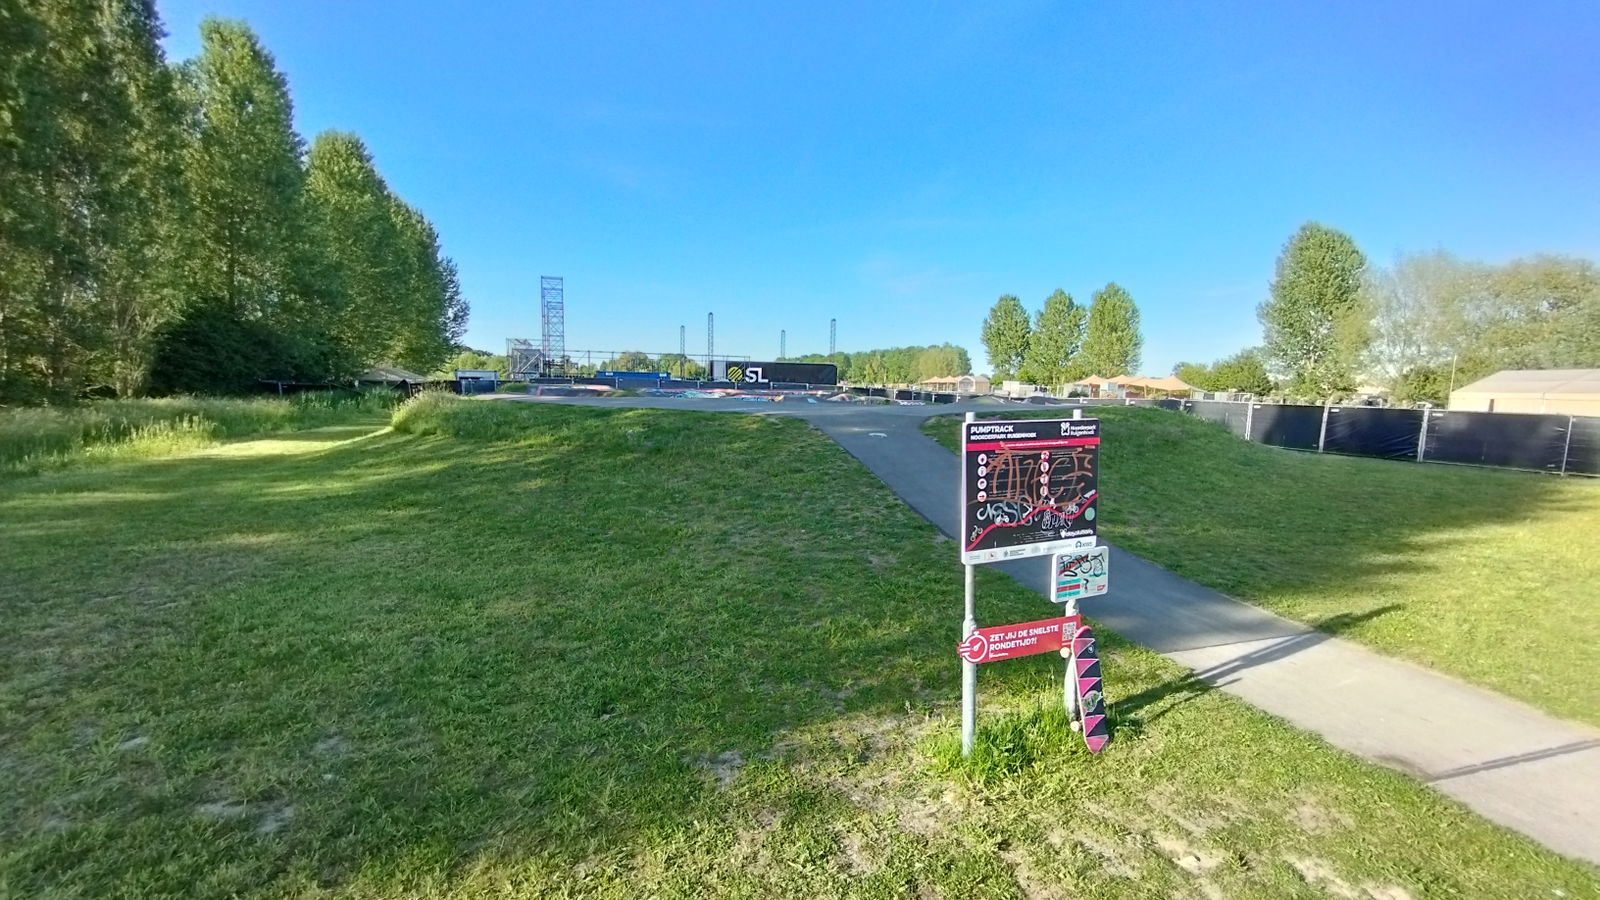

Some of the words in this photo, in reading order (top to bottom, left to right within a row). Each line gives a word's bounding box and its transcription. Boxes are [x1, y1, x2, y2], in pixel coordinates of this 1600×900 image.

[745, 367, 769, 383] SL
[970, 425, 1014, 434] PUMPTRACK
[989, 634, 1005, 642] ZET
[1005, 631, 1017, 640] JIJ
[1018, 629, 1028, 638] DE
[1029, 624, 1059, 636] SNELSTE
[989, 637, 1037, 651] RONDETIJD?!
